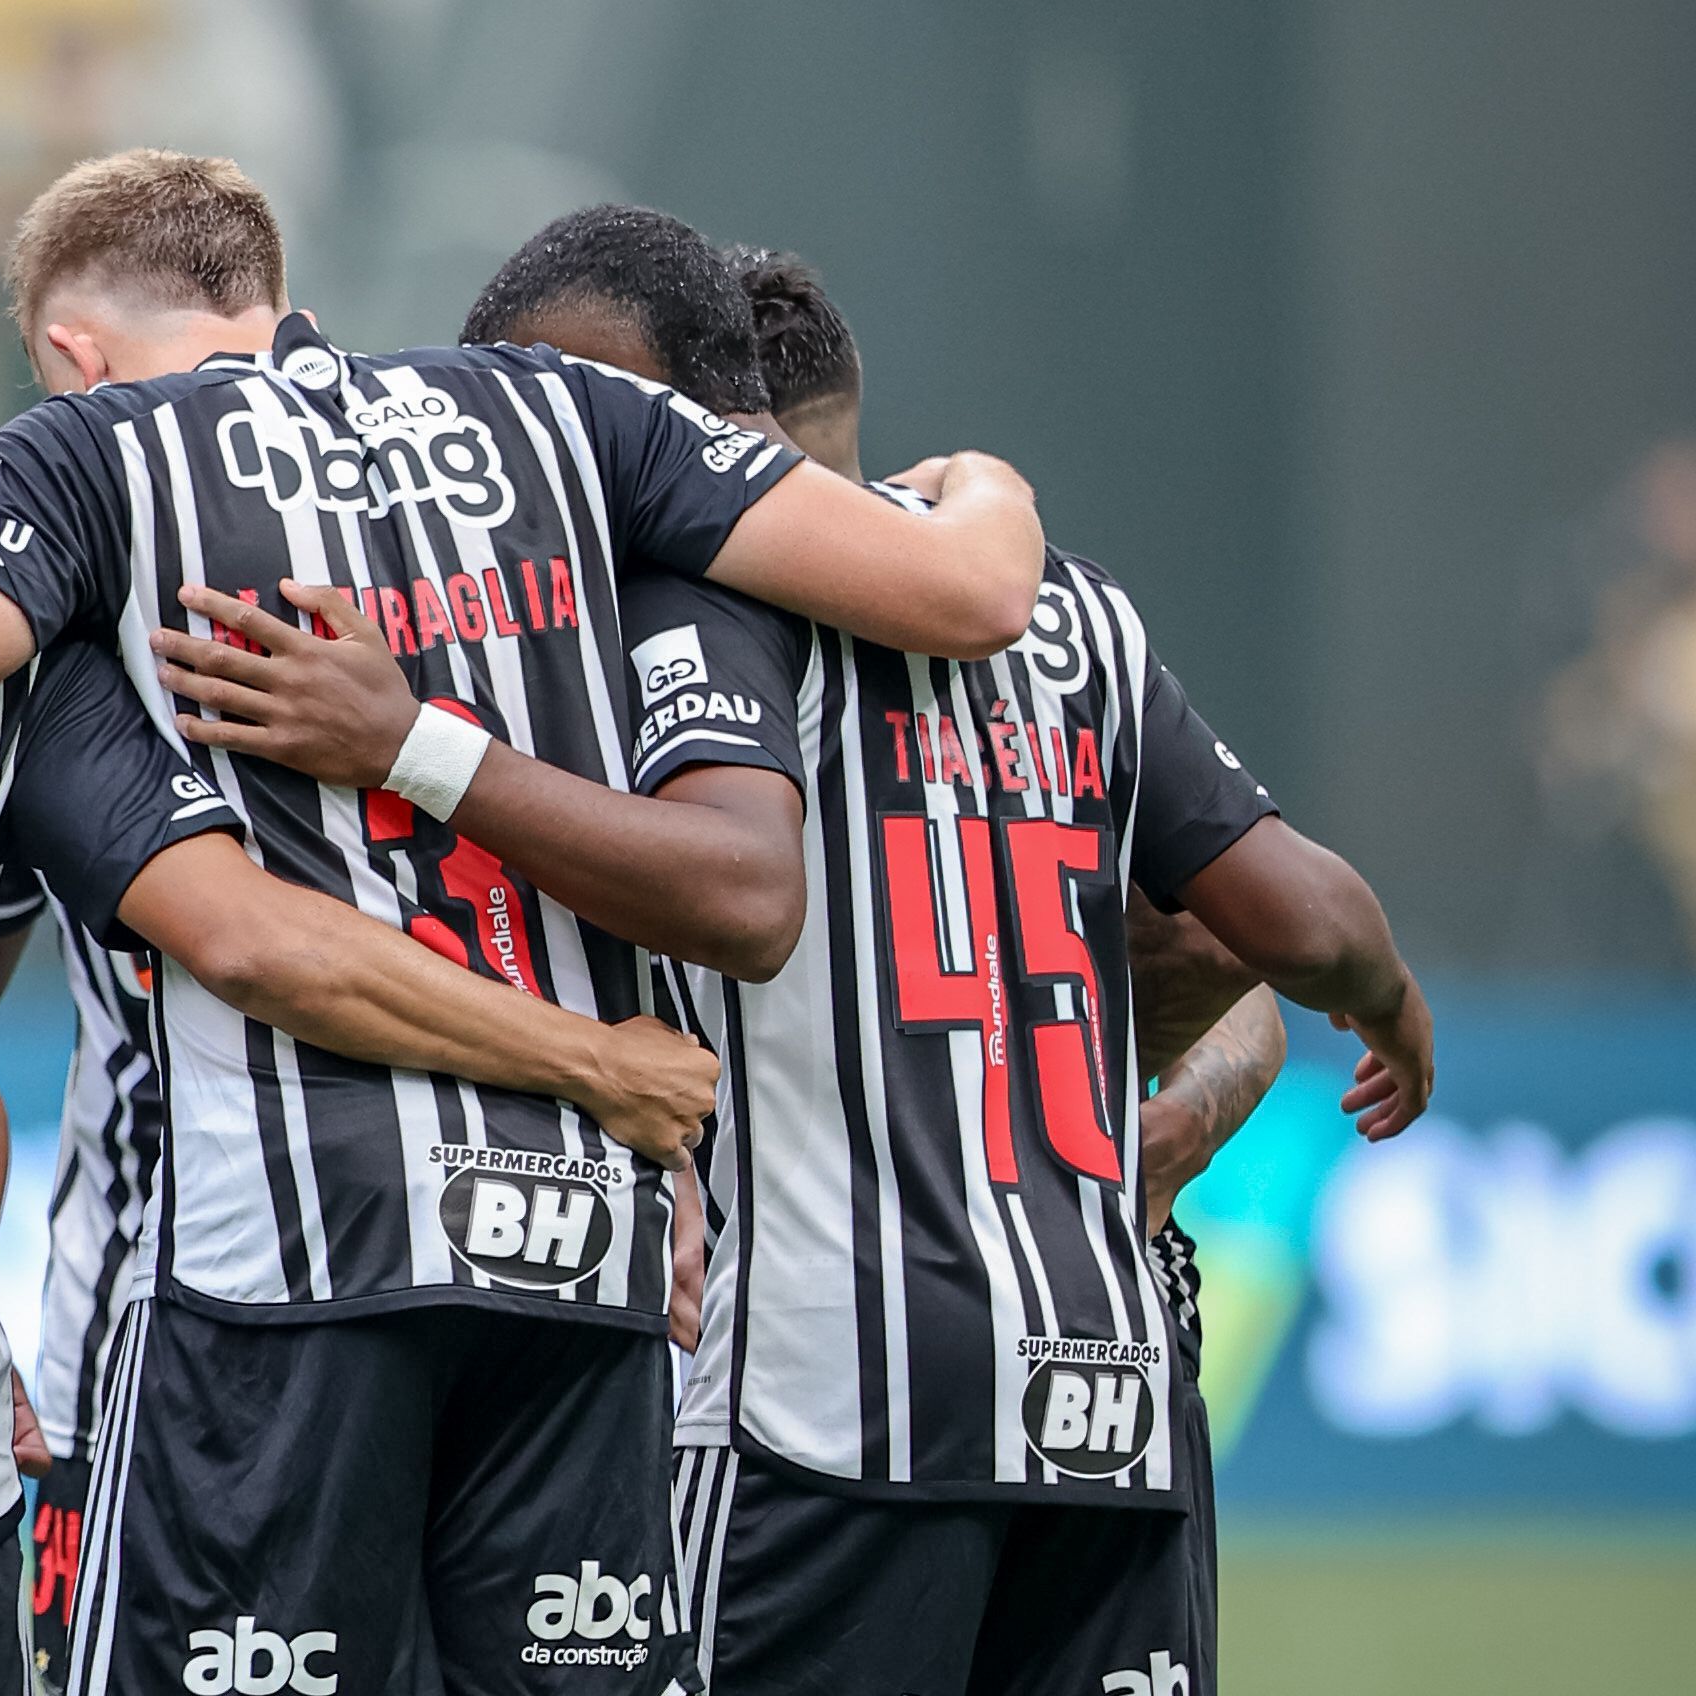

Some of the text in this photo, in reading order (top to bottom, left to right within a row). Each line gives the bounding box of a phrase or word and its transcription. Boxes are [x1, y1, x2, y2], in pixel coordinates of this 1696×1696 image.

[355, 396, 446, 428] GALO
[885, 709, 974, 787] TIA
[486, 886, 528, 995] undiale
[883, 815, 1124, 1184] 45
[985, 933, 1005, 1067] mundiale
[427, 1145, 623, 1184] SUPERMERCADOS
[464, 1176, 596, 1270] BH
[1016, 1338, 1161, 1364] SUPERMERCADOS
[1040, 1369, 1142, 1454] BH
[526, 1560, 652, 1641] abc
[182, 1615, 339, 1696] abc
[521, 1642, 649, 1672] da construção
